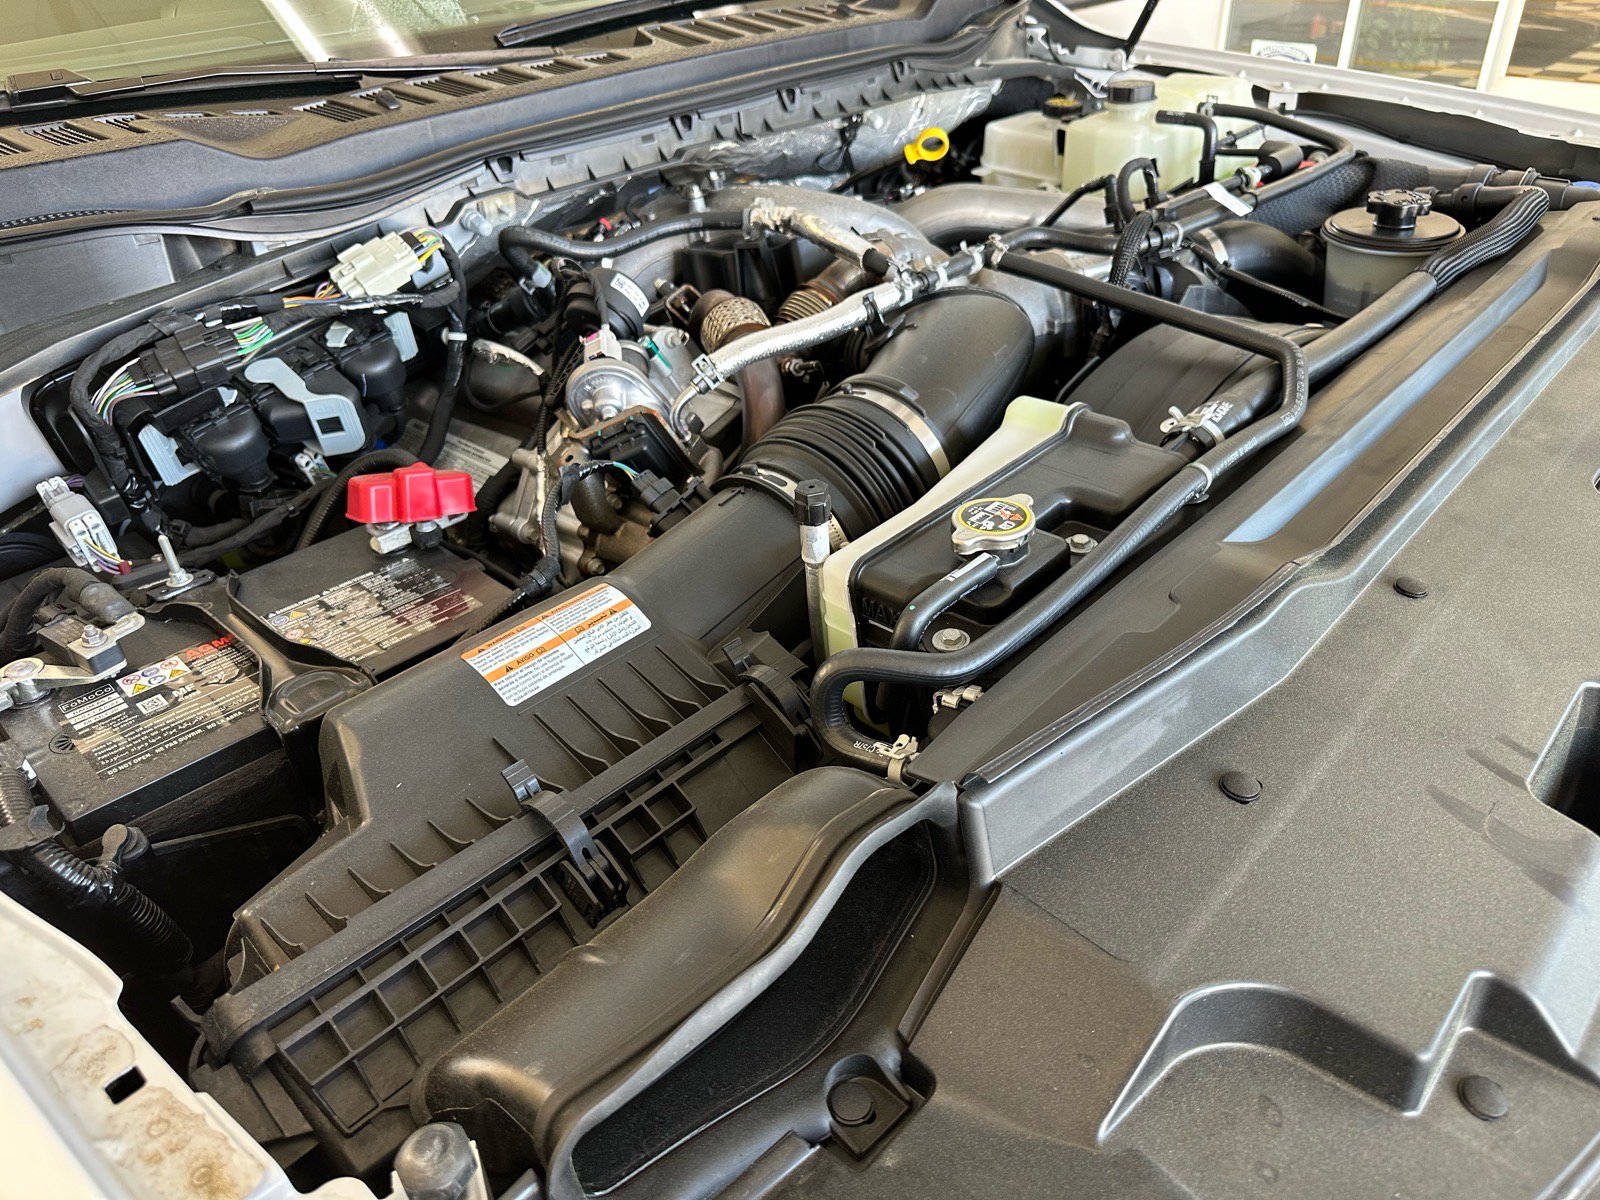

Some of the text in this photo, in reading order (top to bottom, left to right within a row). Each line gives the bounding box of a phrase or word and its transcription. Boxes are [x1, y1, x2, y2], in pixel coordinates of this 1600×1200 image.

[186, 637, 232, 661] AGM
[486, 631, 514, 647] WARNING
[515, 652, 535, 665] AVISO
[61, 686, 111, 710] FoMoCo
[172, 683, 196, 698] MF
[107, 767, 118, 776] DO
[118, 760, 133, 771] NOT
[133, 750, 153, 764] OPEN.
[164, 739, 178, 749] PAS
[178, 726, 205, 743] OUVRIR.
[206, 722, 216, 730] NO
